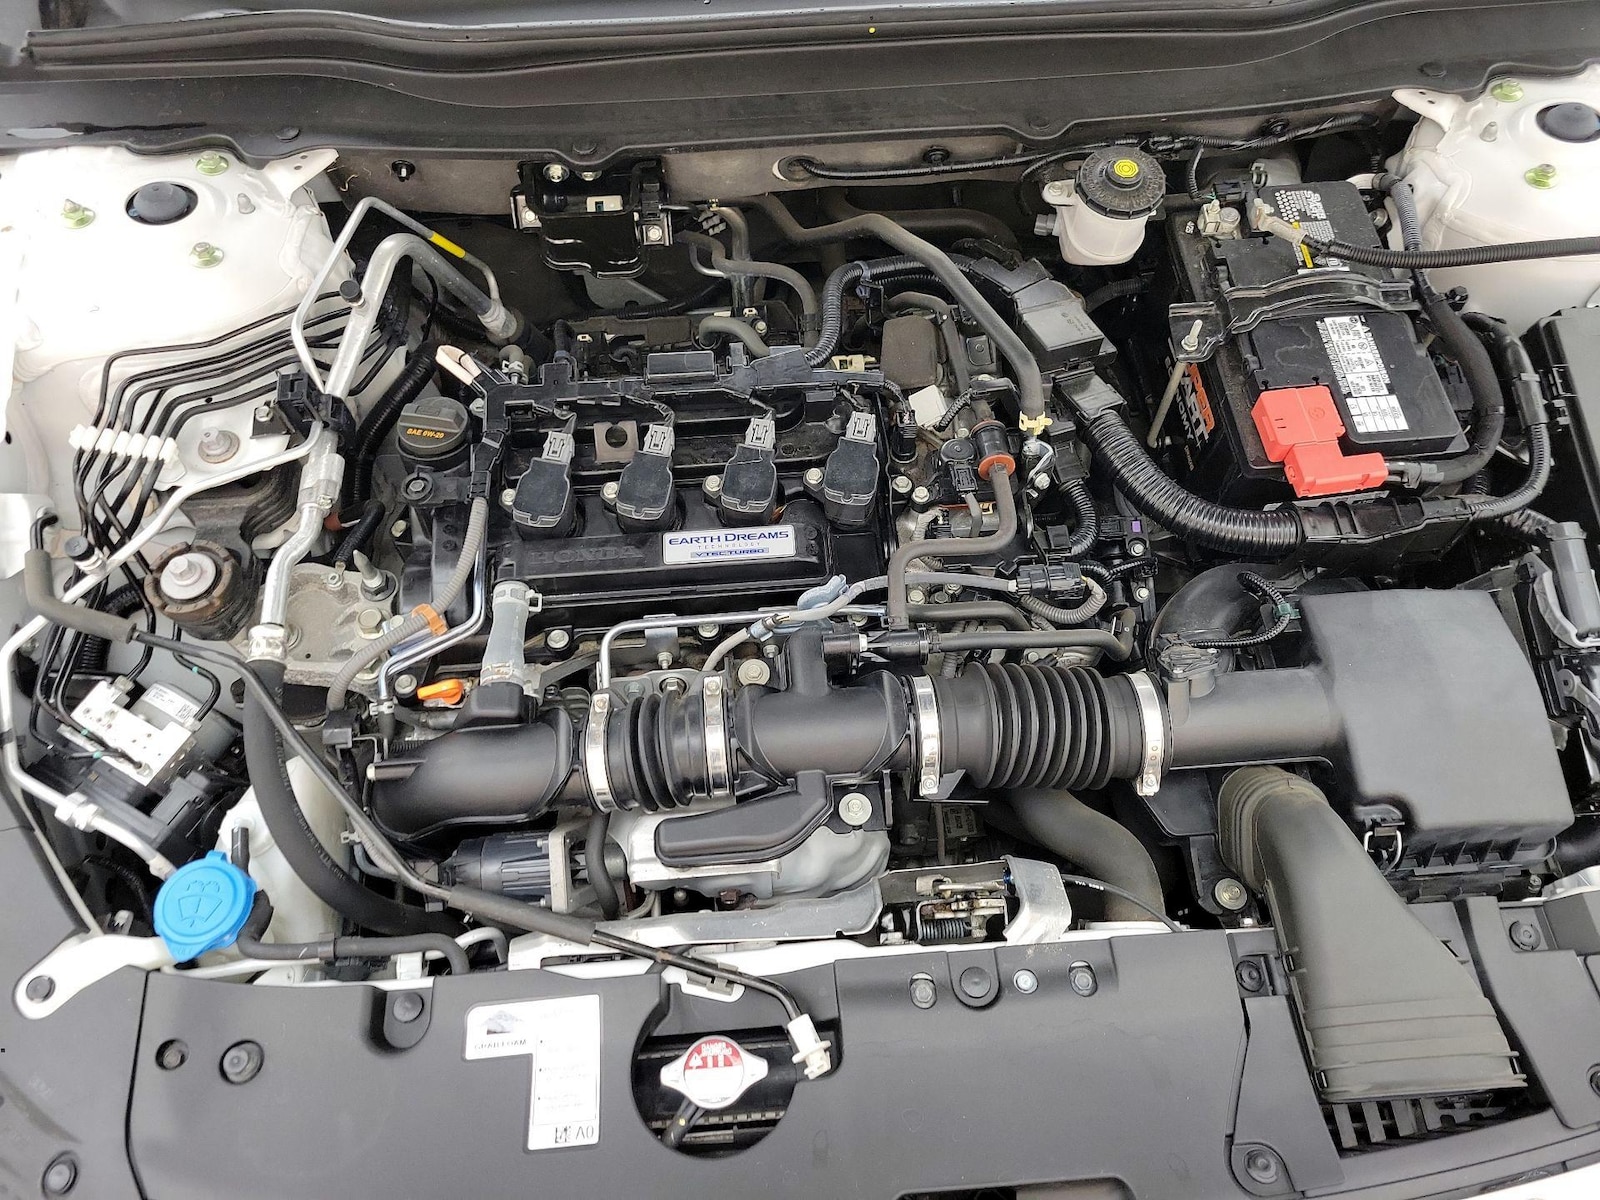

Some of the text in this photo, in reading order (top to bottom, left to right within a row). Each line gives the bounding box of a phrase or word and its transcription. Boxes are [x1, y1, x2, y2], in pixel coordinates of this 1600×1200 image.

[1186, 363, 1215, 433] PER
[406, 428, 422, 436] SAE
[668, 530, 789, 545] EARTH DREAMS
[527, 546, 644, 565] HONDA
